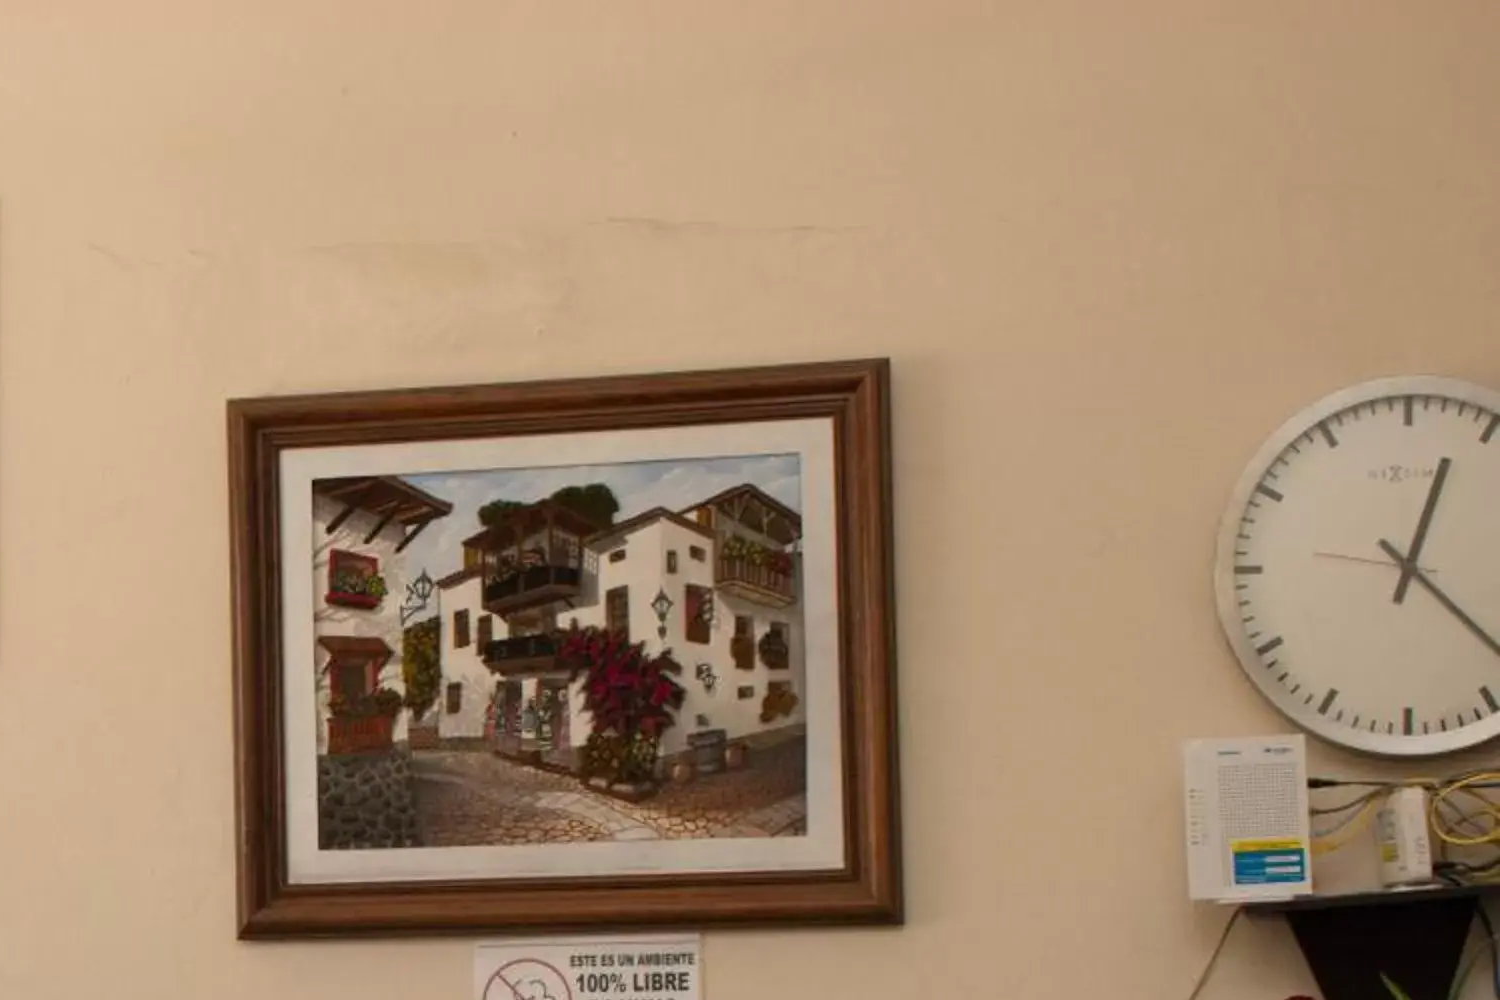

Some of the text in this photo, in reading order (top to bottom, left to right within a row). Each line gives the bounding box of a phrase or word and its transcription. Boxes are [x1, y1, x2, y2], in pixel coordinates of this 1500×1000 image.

[569, 952, 695, 968] ESTE ES UN AMBIENTE
[576, 972, 690, 993] 100% LIBRE
